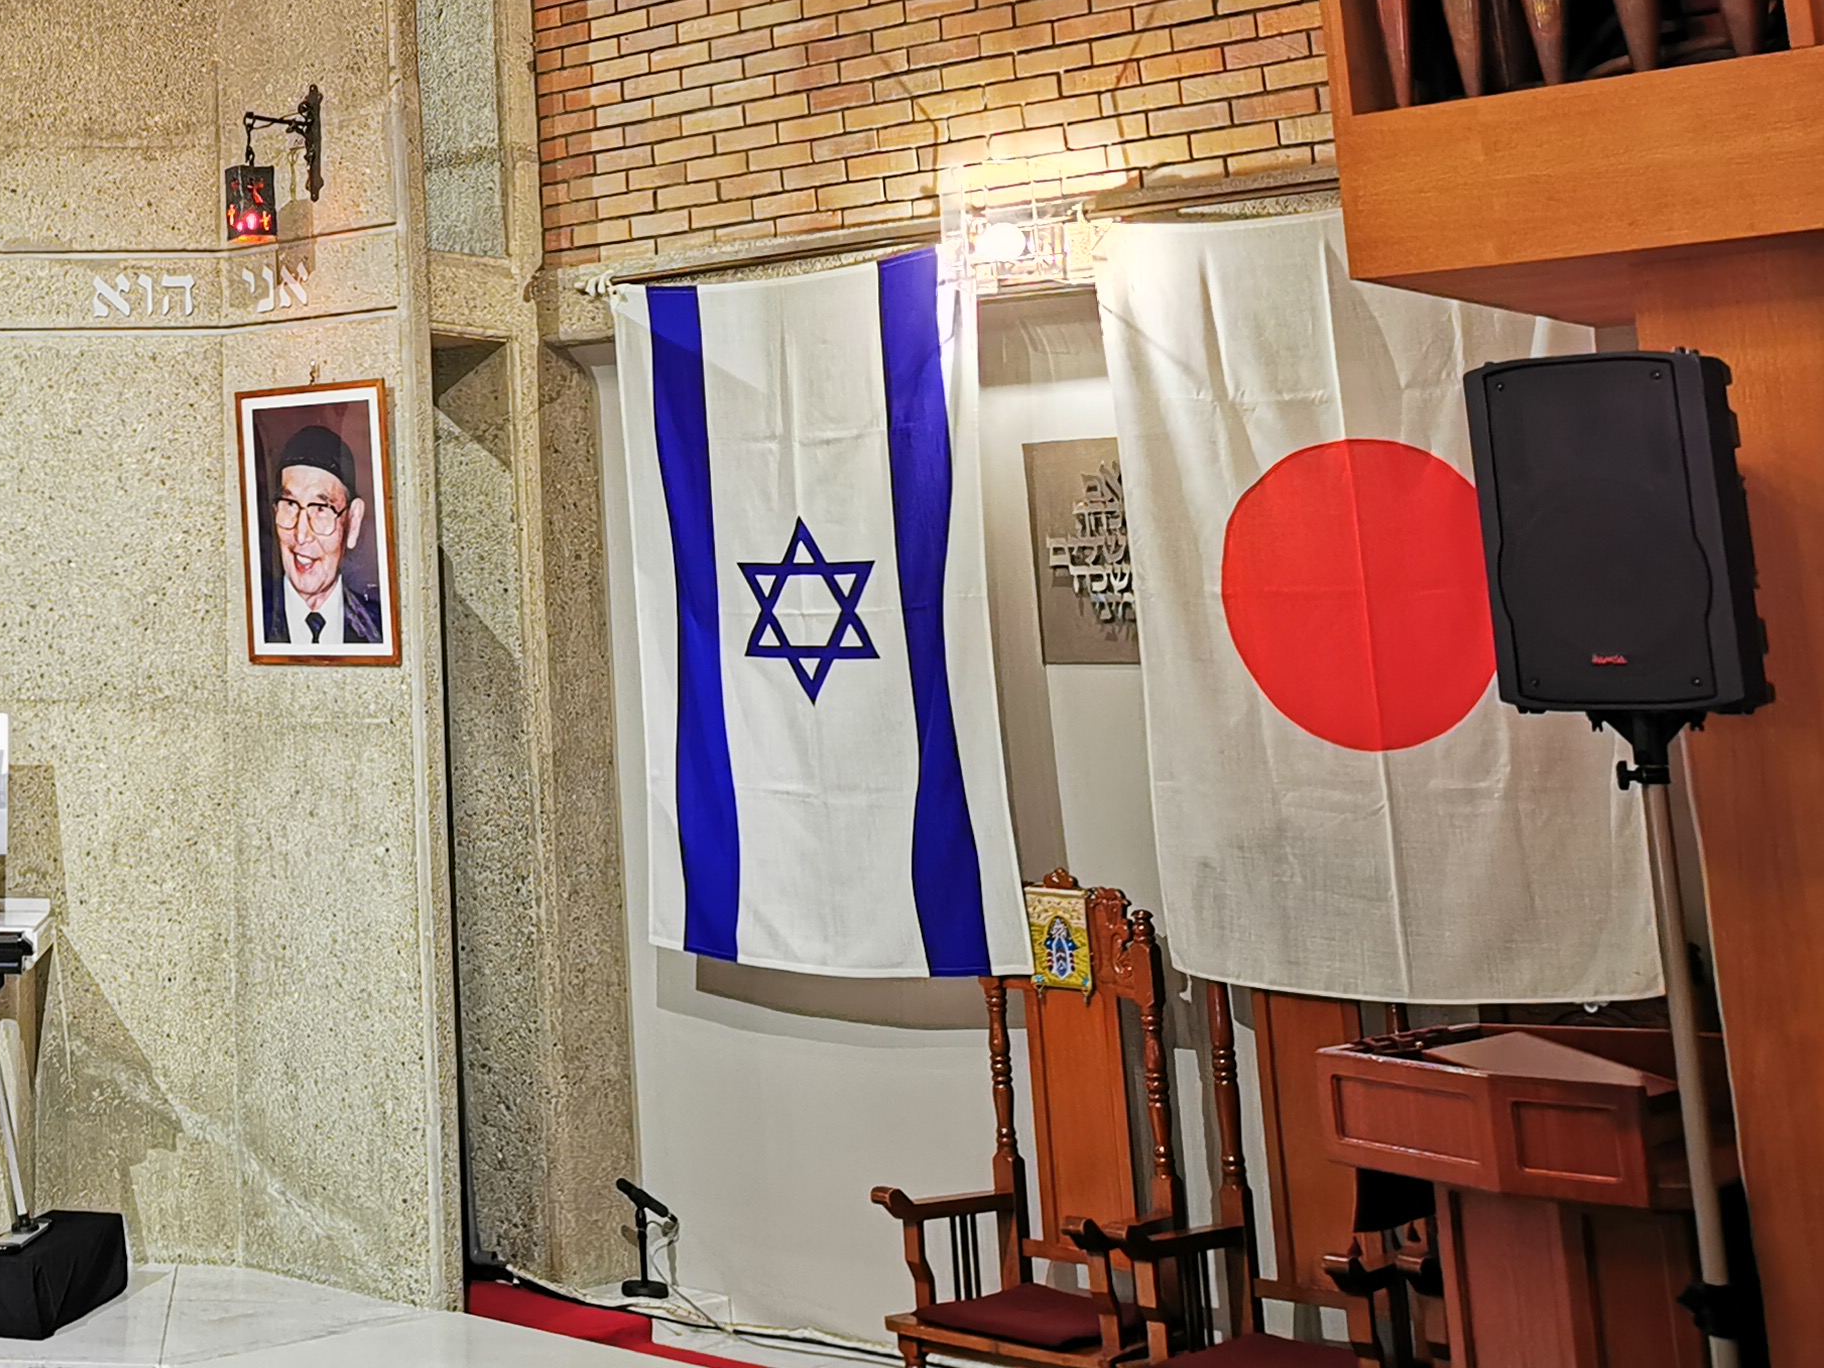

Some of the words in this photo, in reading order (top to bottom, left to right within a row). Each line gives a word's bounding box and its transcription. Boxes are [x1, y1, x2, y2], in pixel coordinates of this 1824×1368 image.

[93, 271, 195, 318] הוא
[241, 261, 311, 314] אני
[1069, 563, 1131, 594] שכח
